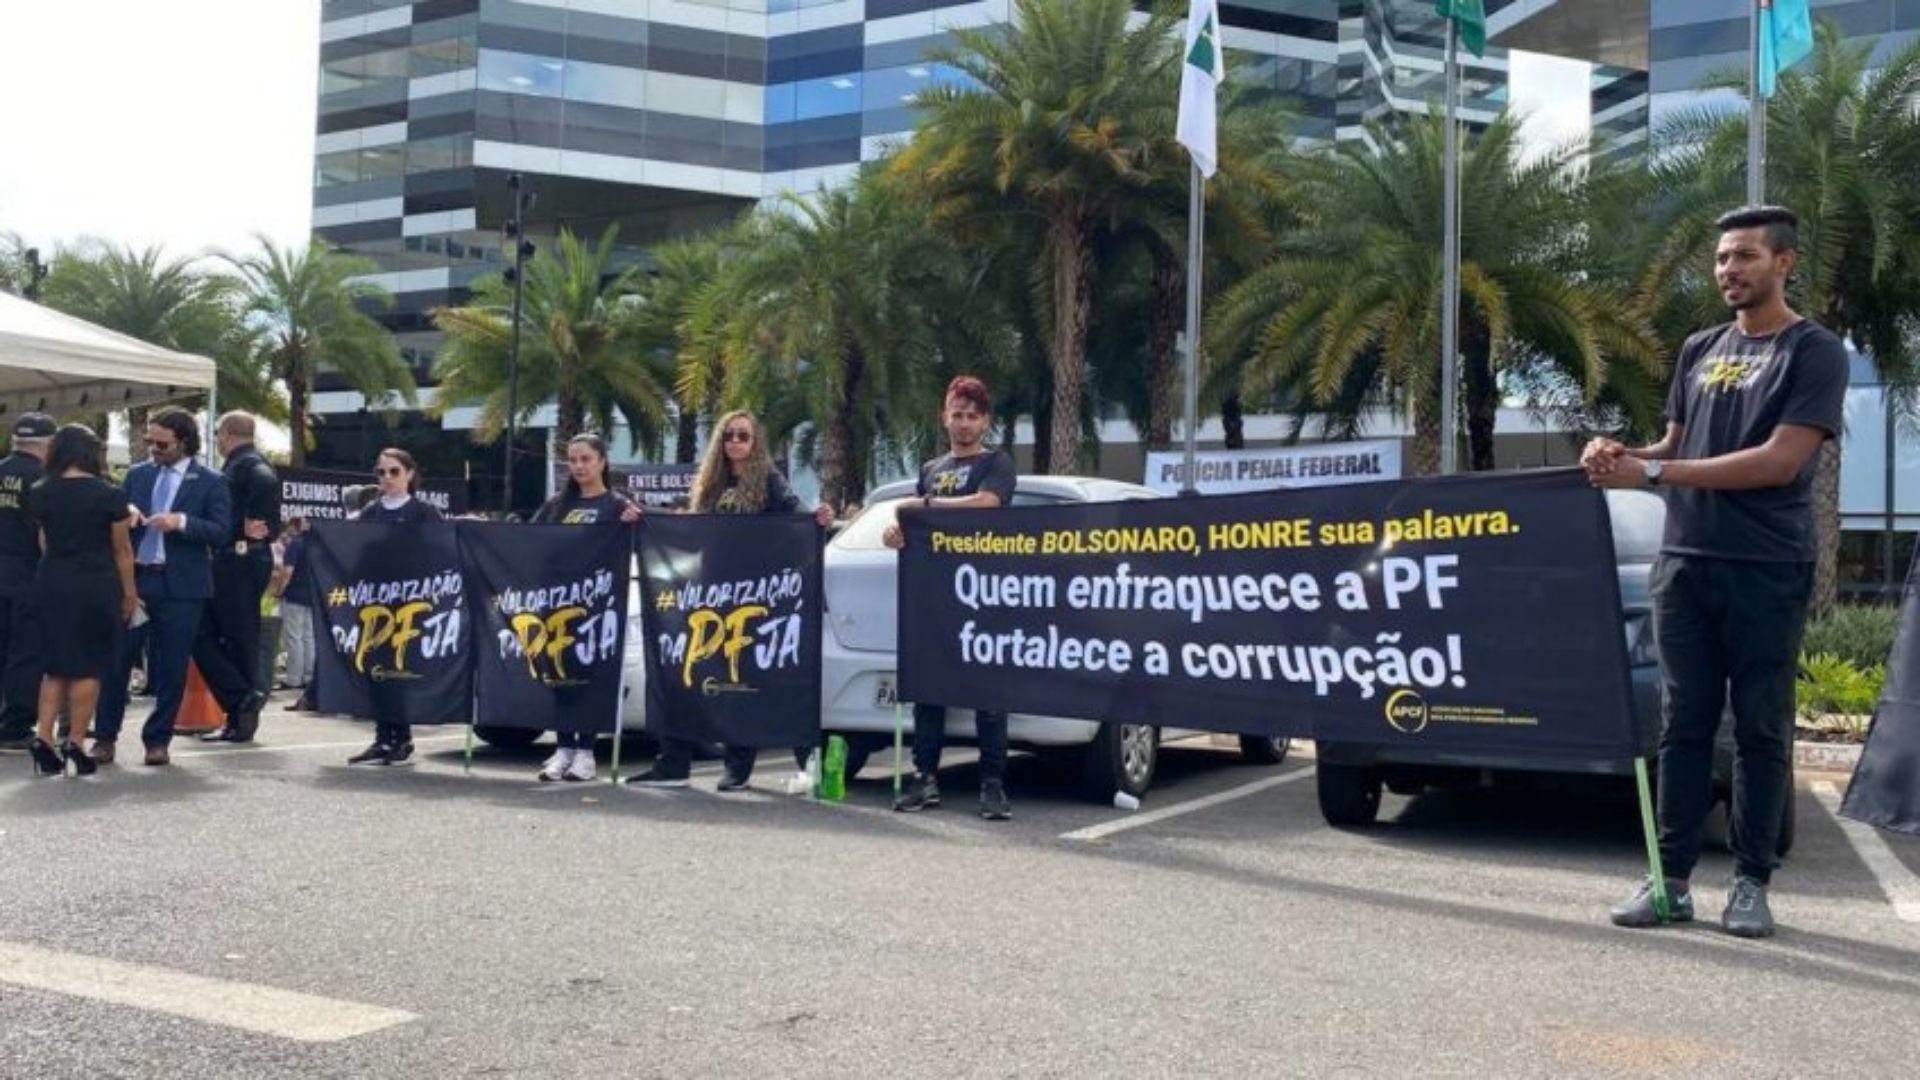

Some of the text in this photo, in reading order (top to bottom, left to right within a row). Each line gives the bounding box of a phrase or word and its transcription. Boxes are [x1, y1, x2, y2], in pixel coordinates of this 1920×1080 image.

[1161, 453, 1382, 483] POÍCIA PENAL FEDERAL
[932, 509, 1521, 557] Presidente BOLSONARO, HONRE sua palavra.
[954, 554, 1459, 623] Quem enfraquece a PF
[355, 602, 433, 673] PF
[421, 596, 462, 659] JÁ
[575, 595, 618, 665] JÁ
[683, 606, 768, 688] PF
[755, 598, 803, 670] JÁ
[959, 620, 1466, 699] fortalece a corrupção!
